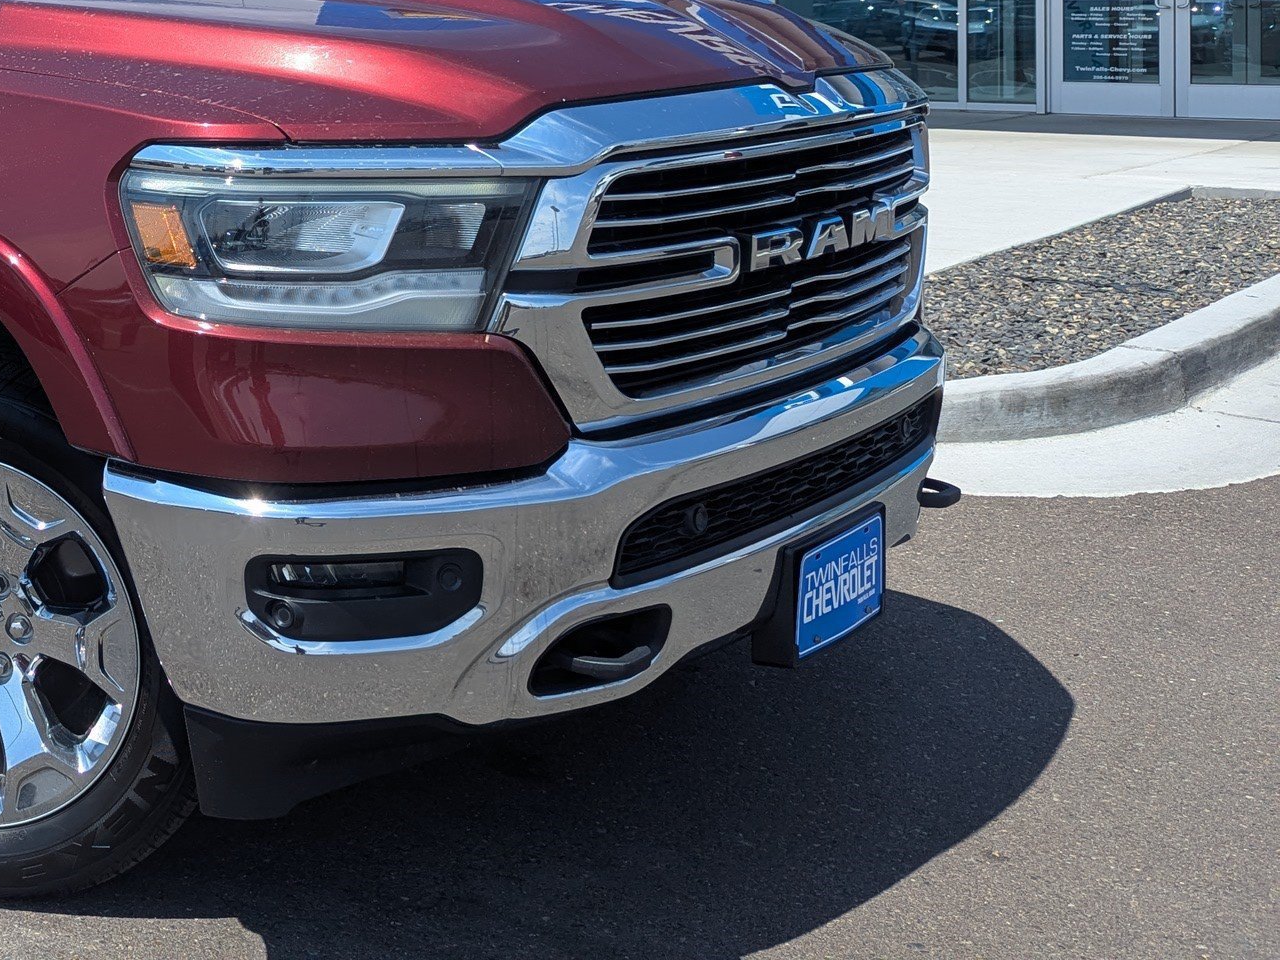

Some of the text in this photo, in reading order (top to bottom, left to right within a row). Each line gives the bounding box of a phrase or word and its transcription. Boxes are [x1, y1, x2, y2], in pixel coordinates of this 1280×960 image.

[750, 201, 891, 272] RAM
[803, 555, 878, 624] CHEVROLET
[805, 537, 878, 592] TWINFALLS
